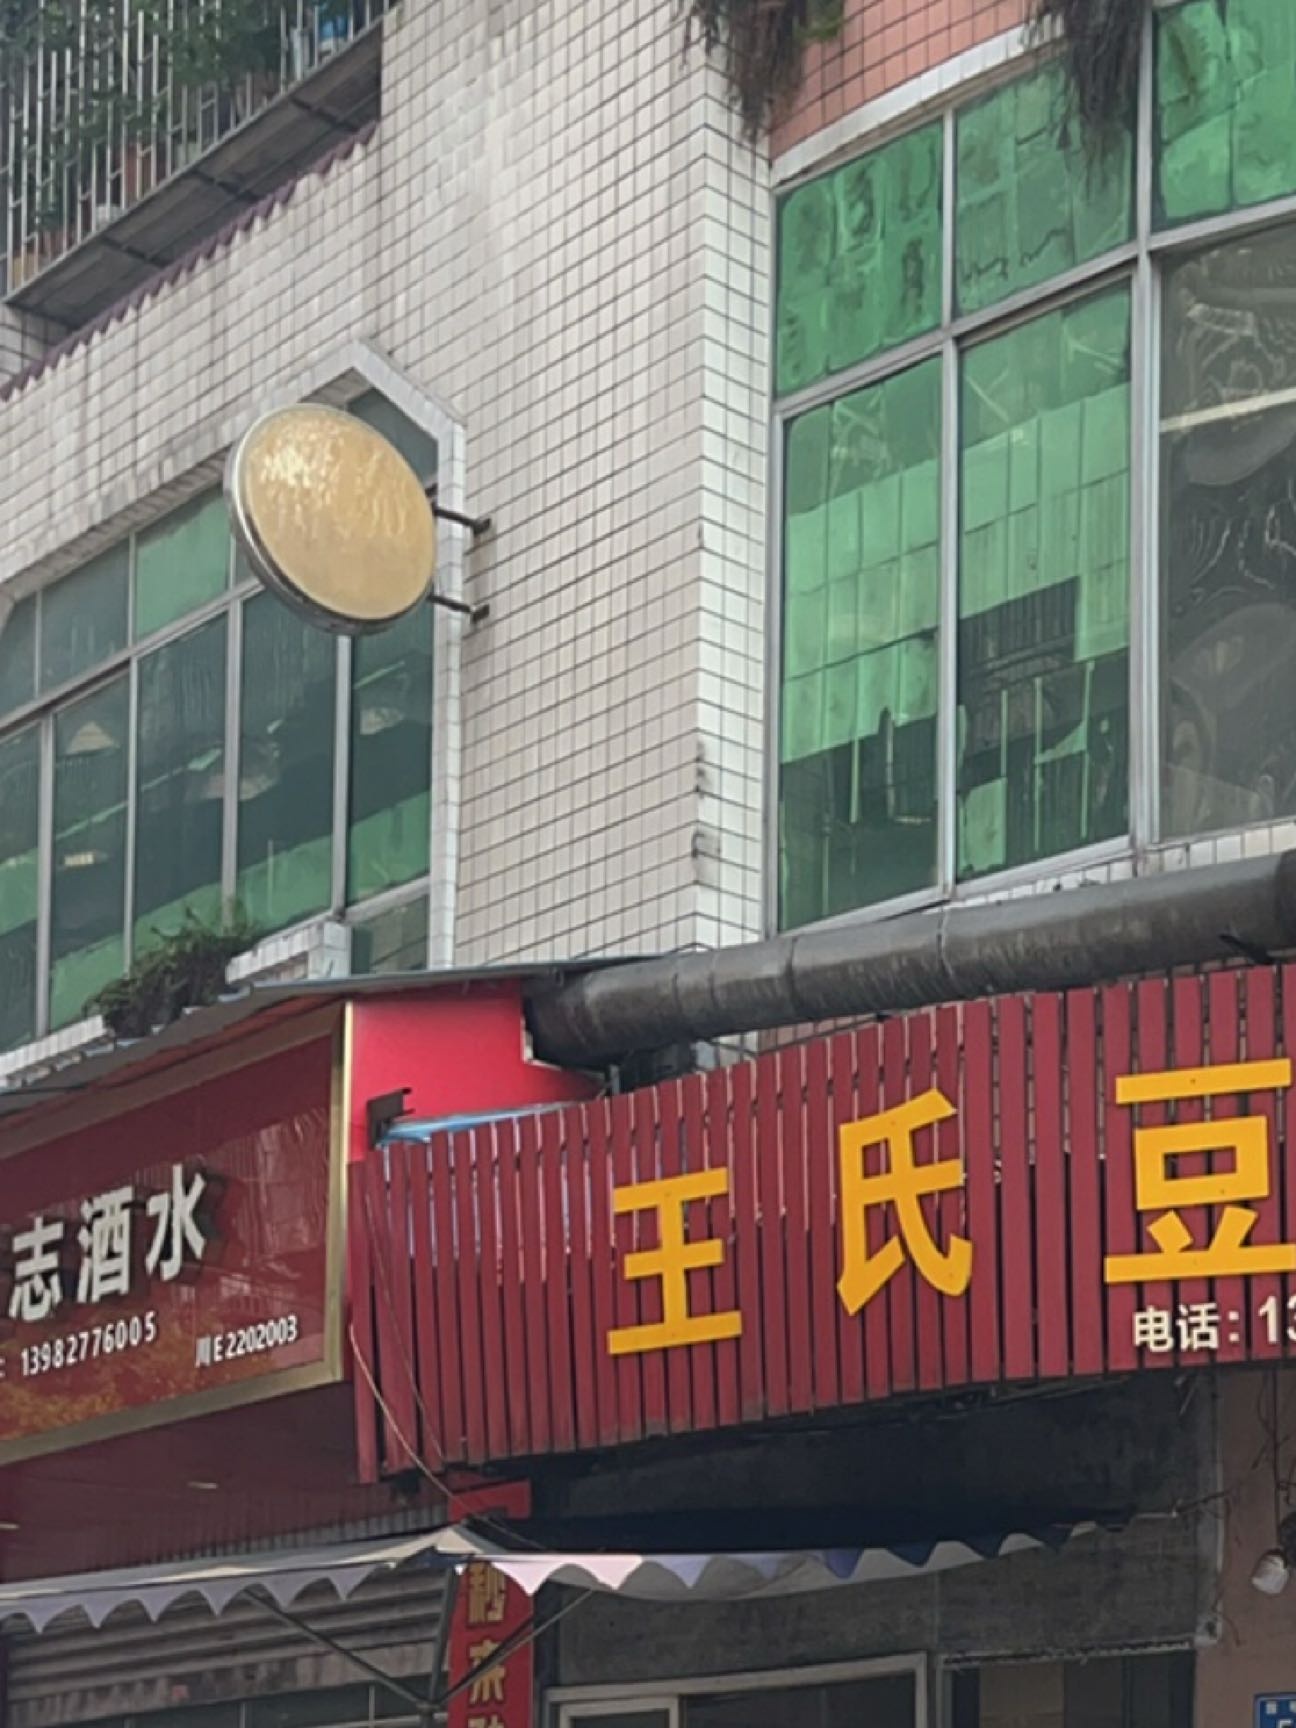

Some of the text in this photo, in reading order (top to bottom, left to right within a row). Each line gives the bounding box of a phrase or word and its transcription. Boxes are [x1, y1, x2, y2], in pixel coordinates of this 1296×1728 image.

[8, 1163, 207, 1322] 志酒水
[20, 1310, 157, 1377] 13982776005
